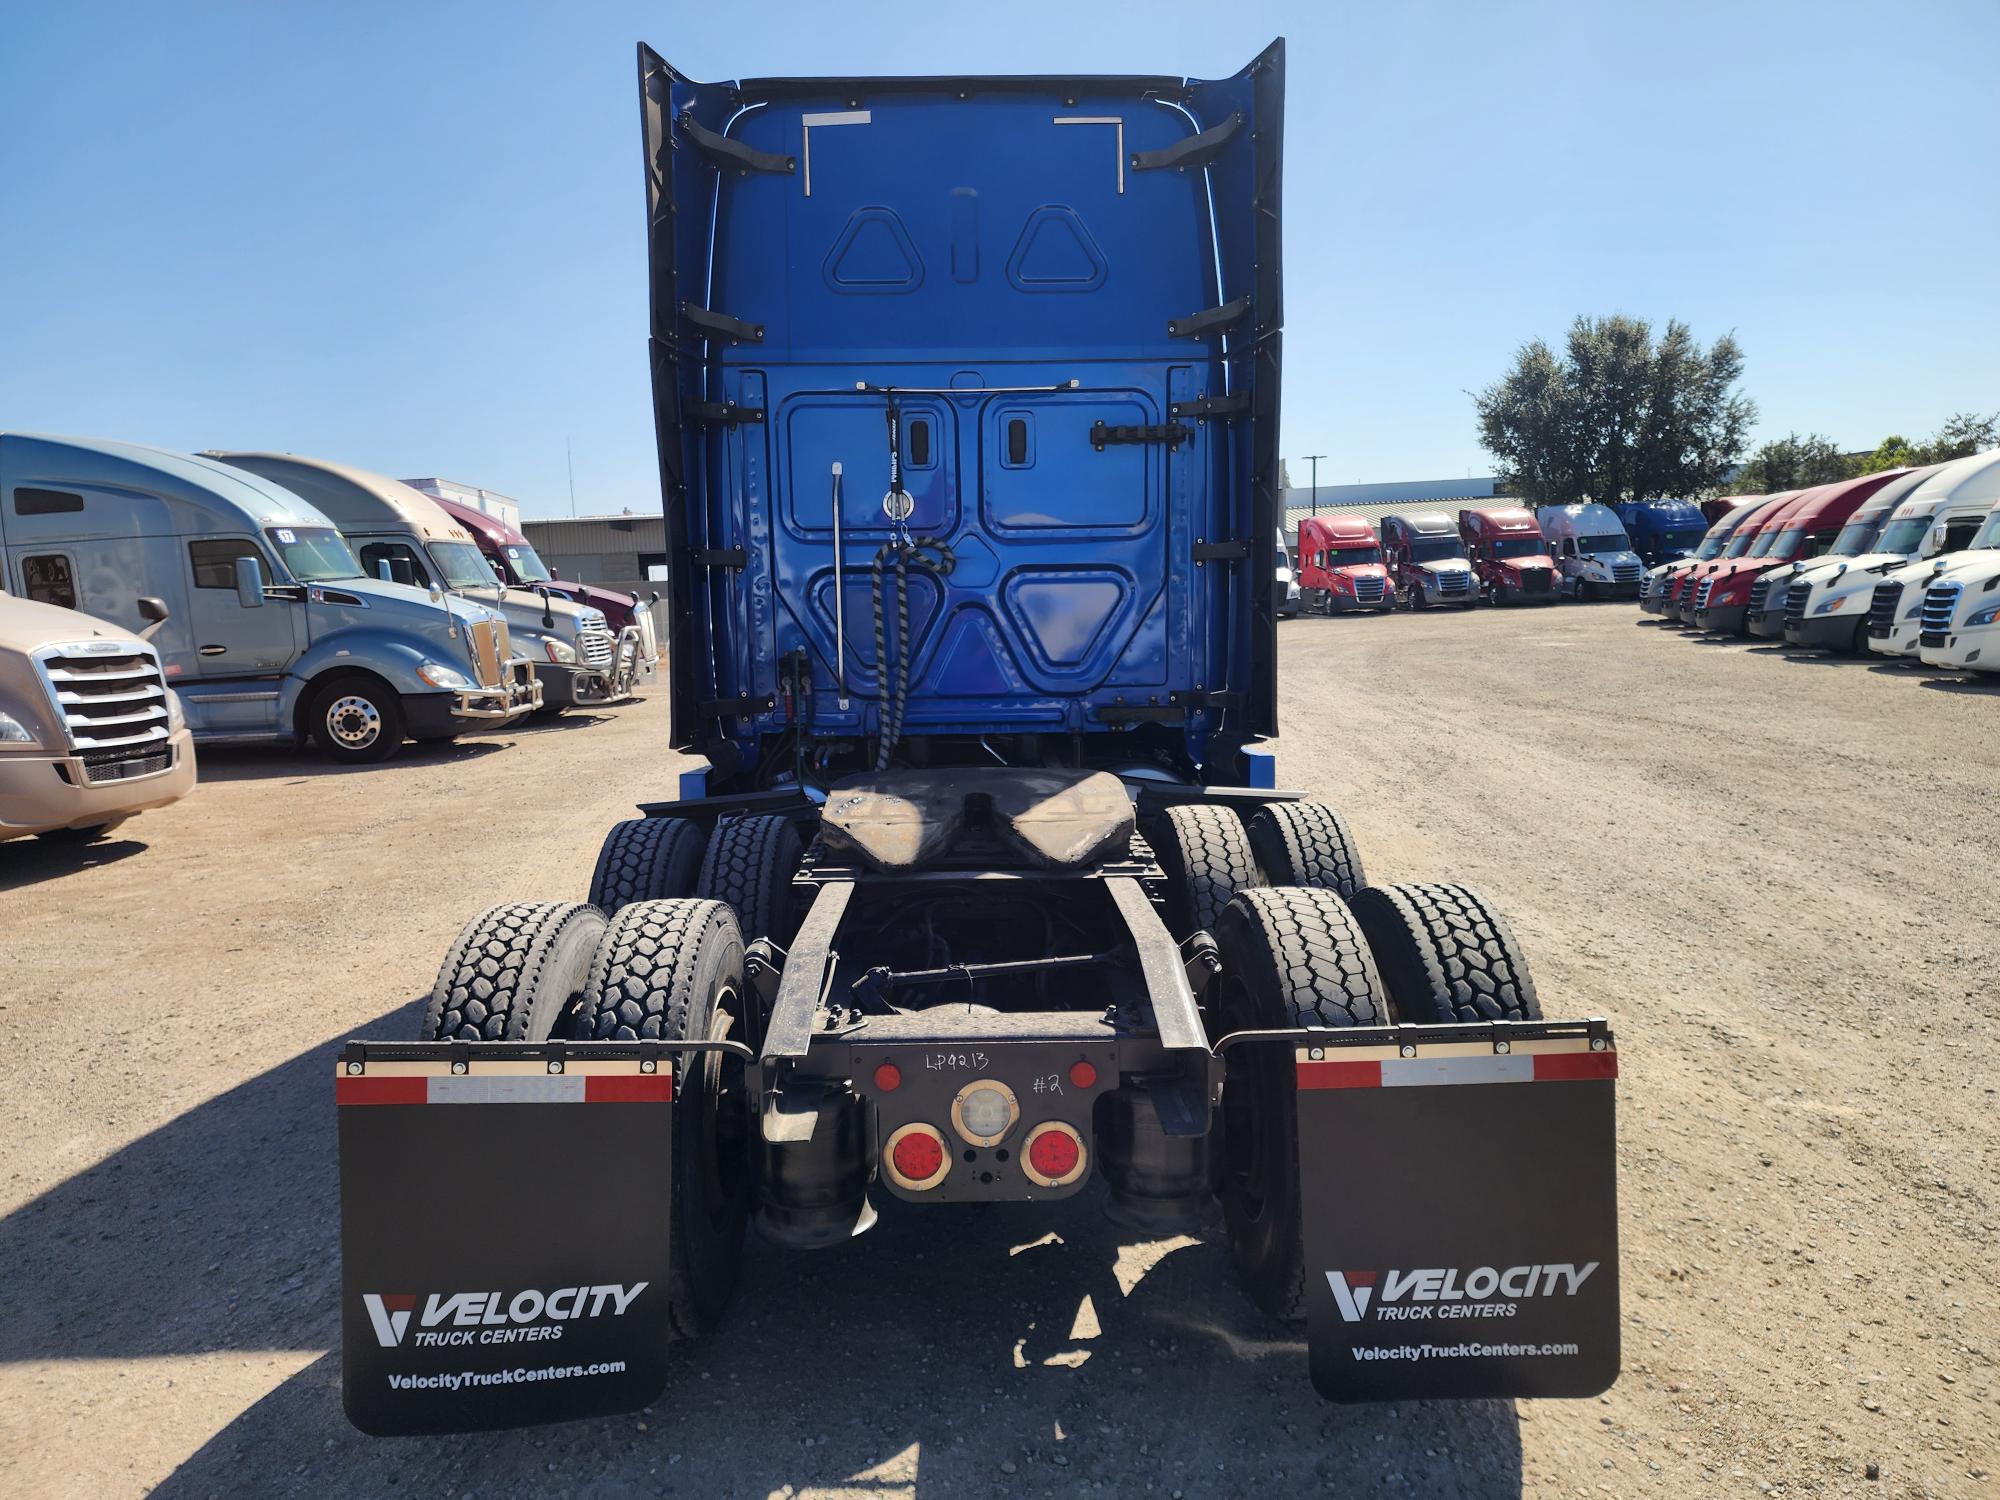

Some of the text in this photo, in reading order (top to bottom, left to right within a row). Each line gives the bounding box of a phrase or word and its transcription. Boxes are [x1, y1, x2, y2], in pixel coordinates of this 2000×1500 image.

[926, 1052, 989, 1071] LP9213
[1033, 1074, 1064, 1096] #2
[1381, 1261, 1600, 1302] VELOCITY
[420, 1281, 649, 1327] VELOCITY
[1376, 1303, 1518, 1321] TRUCK CENTERS
[414, 1326, 564, 1348] TRUCK CENTERS
[1352, 1342, 1579, 1362] VelocityTruckCenters.com
[387, 1359, 627, 1391] VelocityTruckCenters.com
